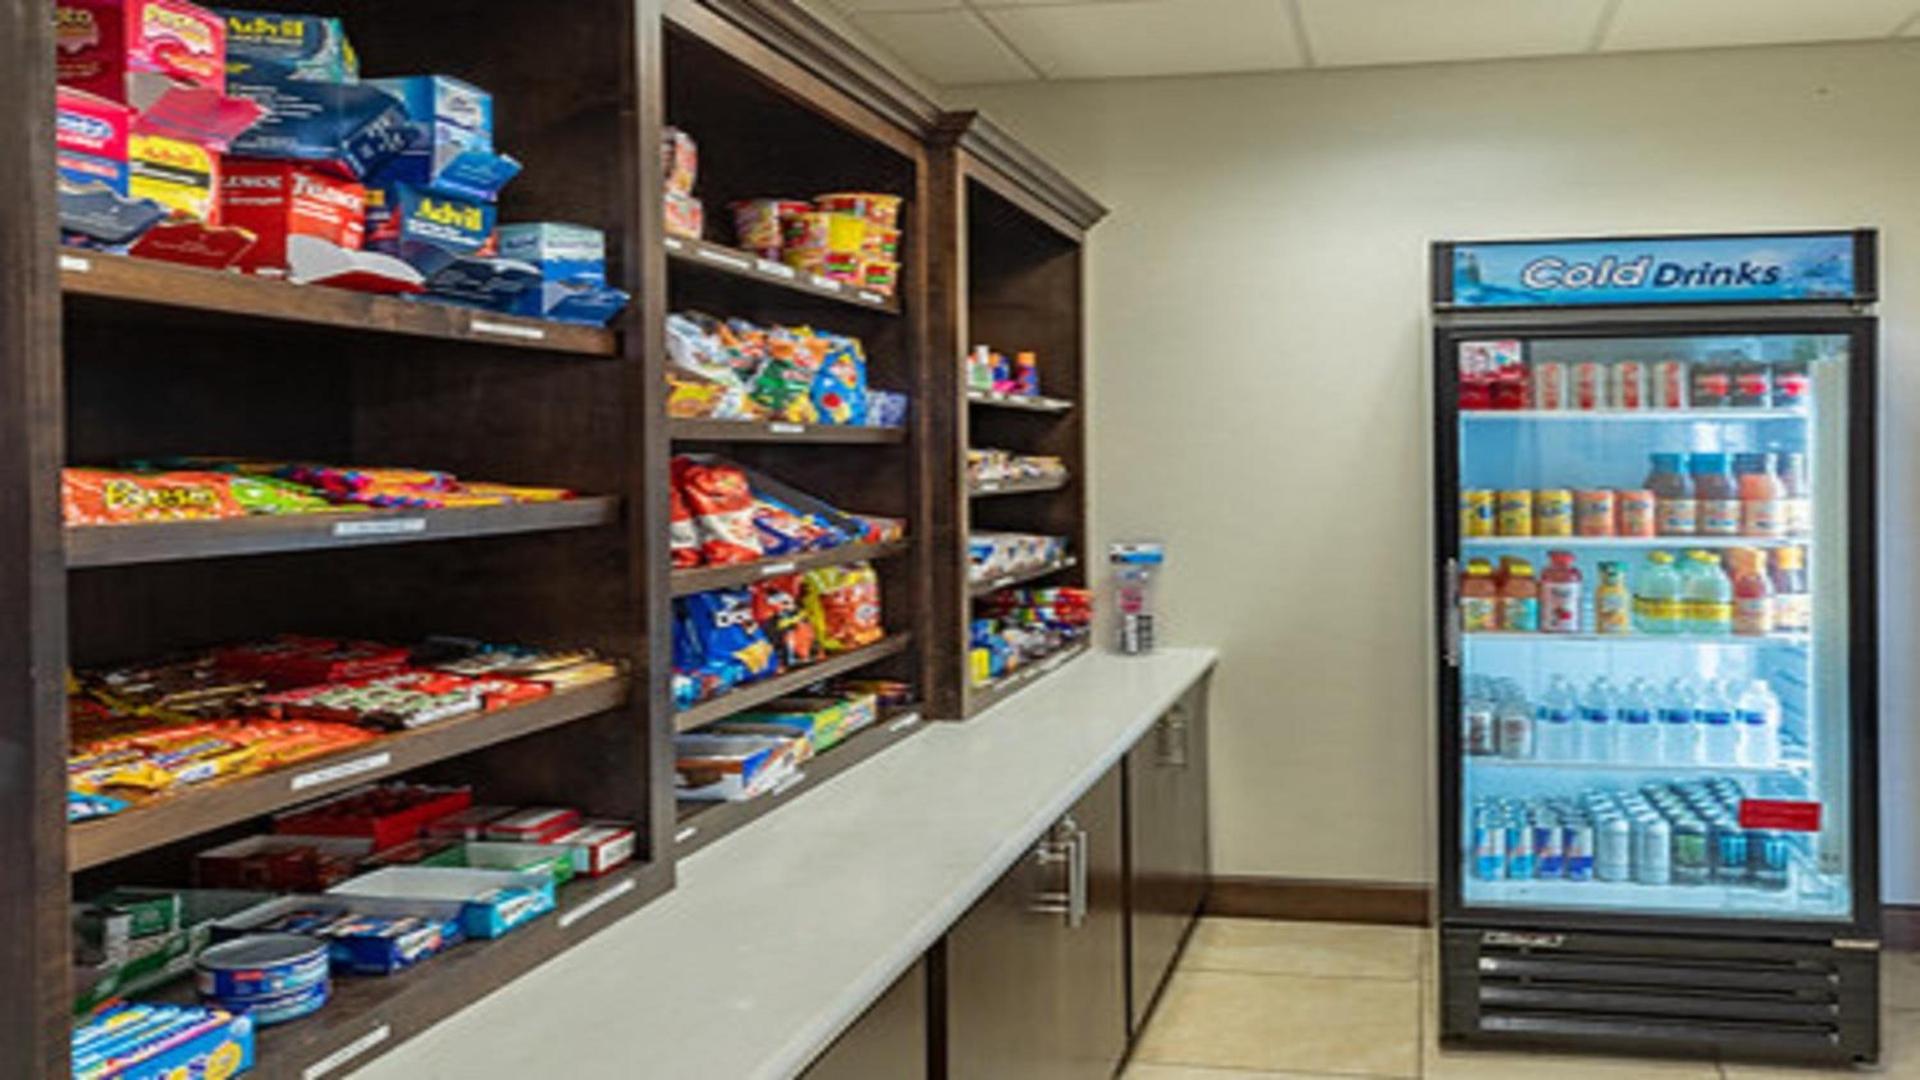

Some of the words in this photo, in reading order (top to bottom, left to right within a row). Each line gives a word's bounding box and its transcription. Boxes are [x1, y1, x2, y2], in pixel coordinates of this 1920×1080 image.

[415, 197, 482, 231] Advil
[1521, 254, 1654, 289] Cold
[1653, 260, 1782, 288] Drinks
